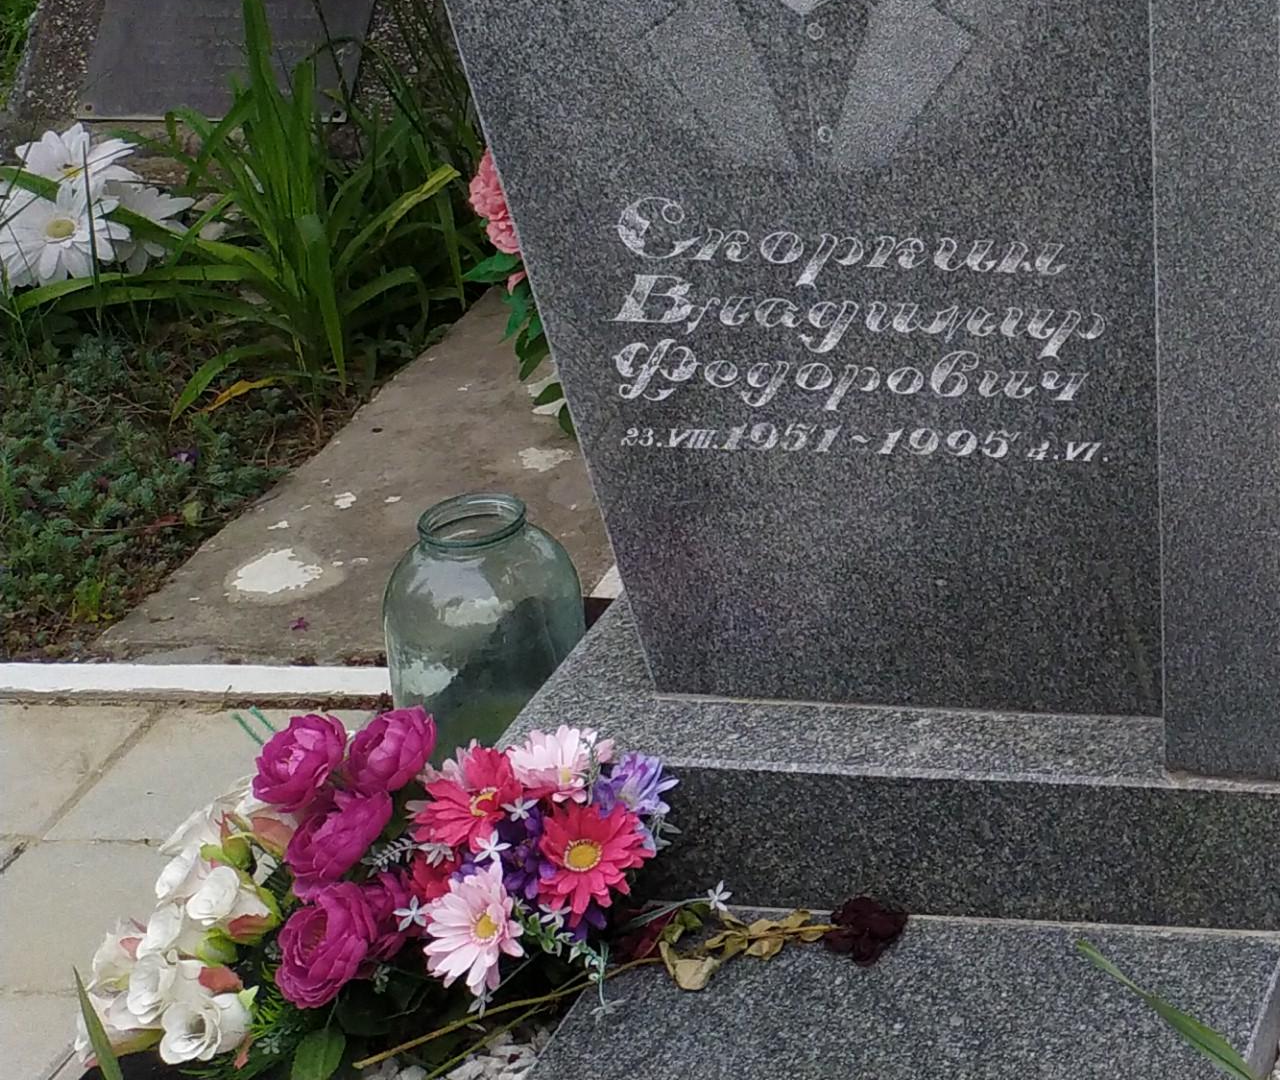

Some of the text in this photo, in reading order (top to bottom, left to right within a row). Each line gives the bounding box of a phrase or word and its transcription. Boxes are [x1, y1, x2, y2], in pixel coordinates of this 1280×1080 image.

[617, 196, 1066, 287] Скоркин
[612, 273, 1107, 360] Владимир
[612, 338, 1090, 410] Федорович
